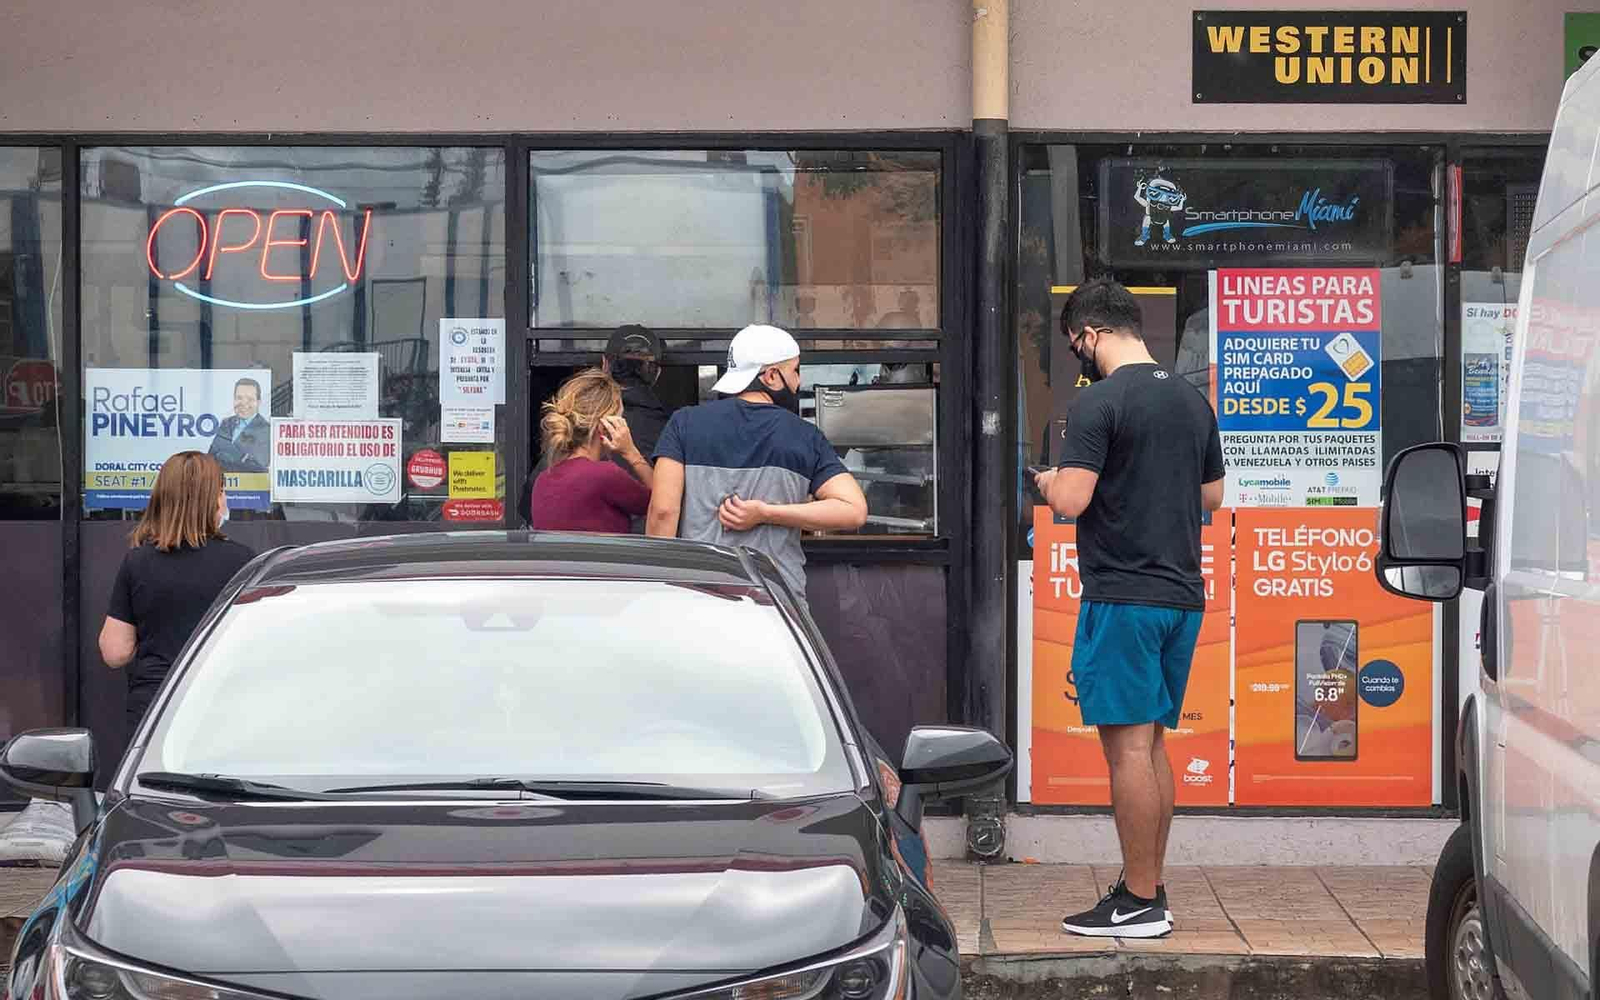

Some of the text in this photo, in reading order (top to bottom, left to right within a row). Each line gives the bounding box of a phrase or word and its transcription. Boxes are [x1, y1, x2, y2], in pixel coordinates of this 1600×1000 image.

[1207, 26, 1419, 53] WESTERN
[1274, 56, 1419, 84] UNION
[147, 207, 372, 280] OPEN
[1150, 240, 1352, 252] www.smartphonemiami.com
[1223, 276, 1374, 295] LINEAS PARA
[1222, 299, 1374, 324] TURISTAS
[1480, 308, 1500, 320] hay
[1224, 338, 1320, 352] ADQUIERE TU
[1224, 352, 1293, 365] SIM CARD
[1224, 367, 1313, 380] PREPAGADO
[1224, 379, 1260, 395] AQUÍ
[93, 386, 183, 412] Rafael
[1224, 398, 1290, 415] DESDE
[92, 413, 219, 437] PINEYRO
[279, 424, 394, 440] PARA SER ATENDIDO ES
[1223, 435, 1376, 445] PREGUNTA POR TUS PAQUETES
[277, 442, 396, 457] OBLIGATORIO EL USO DE
[1223, 447, 1376, 456] CON LLAMADAS ILIMITADAS
[95, 463, 126, 471] DORAL
[128, 463, 147, 471] CITY
[1223, 458, 1376, 467] A VENEZUELA Y OTROS PAISES
[95, 476, 127, 487] SEAT
[131, 477, 146, 487] #1
[277, 469, 363, 487] MASCARILLA
[1238, 477, 1291, 487] Lycamobile
[1253, 525, 1373, 547] TELÉFONO
[1253, 551, 1285, 571] LG
[1253, 578, 1334, 597] GRATIS
[1362, 676, 1399, 684] Cuando te
[1315, 687, 1344, 701] 6.8"
[1366, 684, 1396, 692] cambias
[1183, 773, 1214, 782] boost
